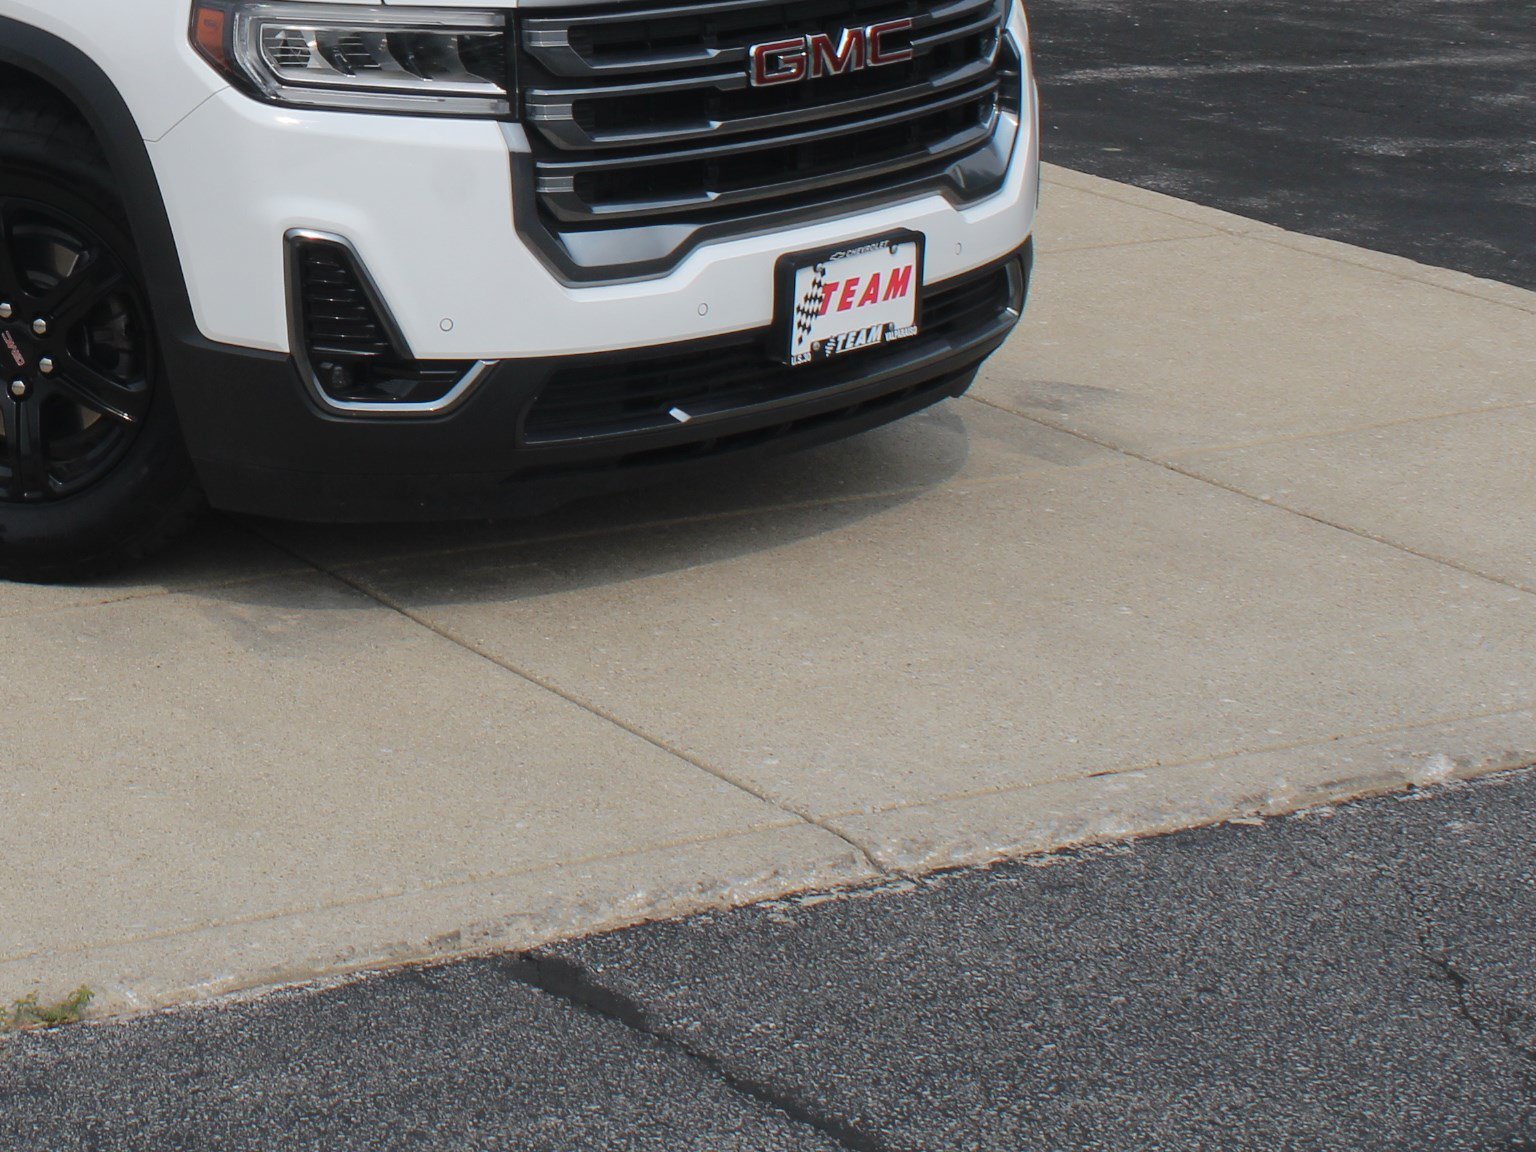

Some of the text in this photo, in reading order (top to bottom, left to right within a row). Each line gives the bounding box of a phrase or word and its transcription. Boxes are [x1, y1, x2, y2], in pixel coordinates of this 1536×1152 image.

[750, 17, 913, 87] GMC
[846, 239, 890, 258] CHEVROLET
[817, 264, 913, 316] TEAM
[835, 323, 884, 352] TEAM
